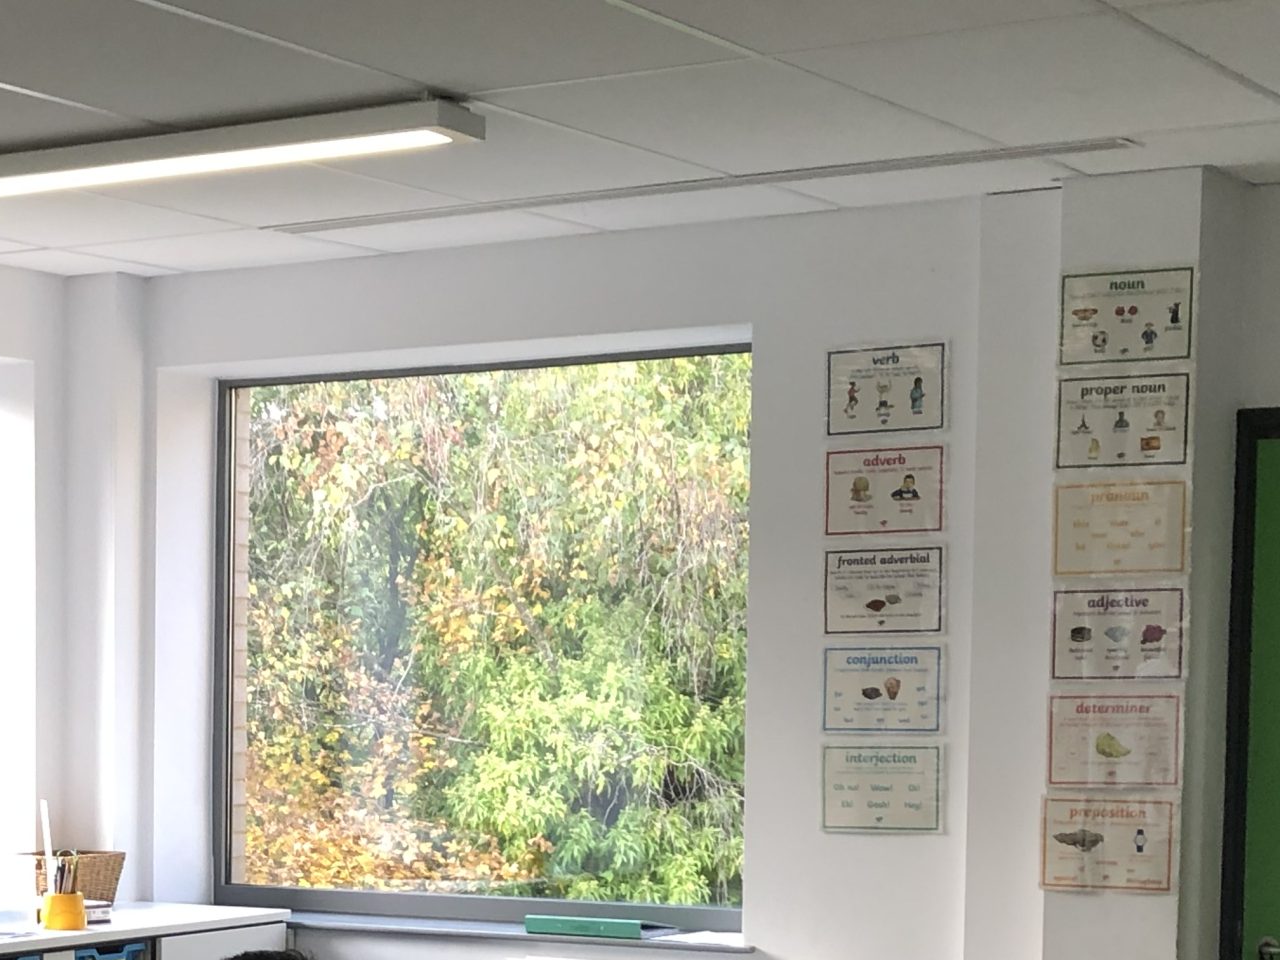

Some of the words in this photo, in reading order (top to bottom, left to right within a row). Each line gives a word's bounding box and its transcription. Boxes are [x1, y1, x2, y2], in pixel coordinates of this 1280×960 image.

[1109, 279, 1145, 291] noun
[872, 352, 900, 366] verb
[1081, 387, 1127, 400] proper
[1131, 383, 1166, 394] noun
[863, 454, 907, 468] adverb
[837, 555, 877, 569] fronted
[880, 551, 931, 566] adverbial
[1087, 595, 1150, 611] adjective
[846, 654, 919, 669] conjunction
[1075, 702, 1152, 714] determiner
[845, 751, 918, 768] interjection
[1070, 808, 1147, 821] preposition
